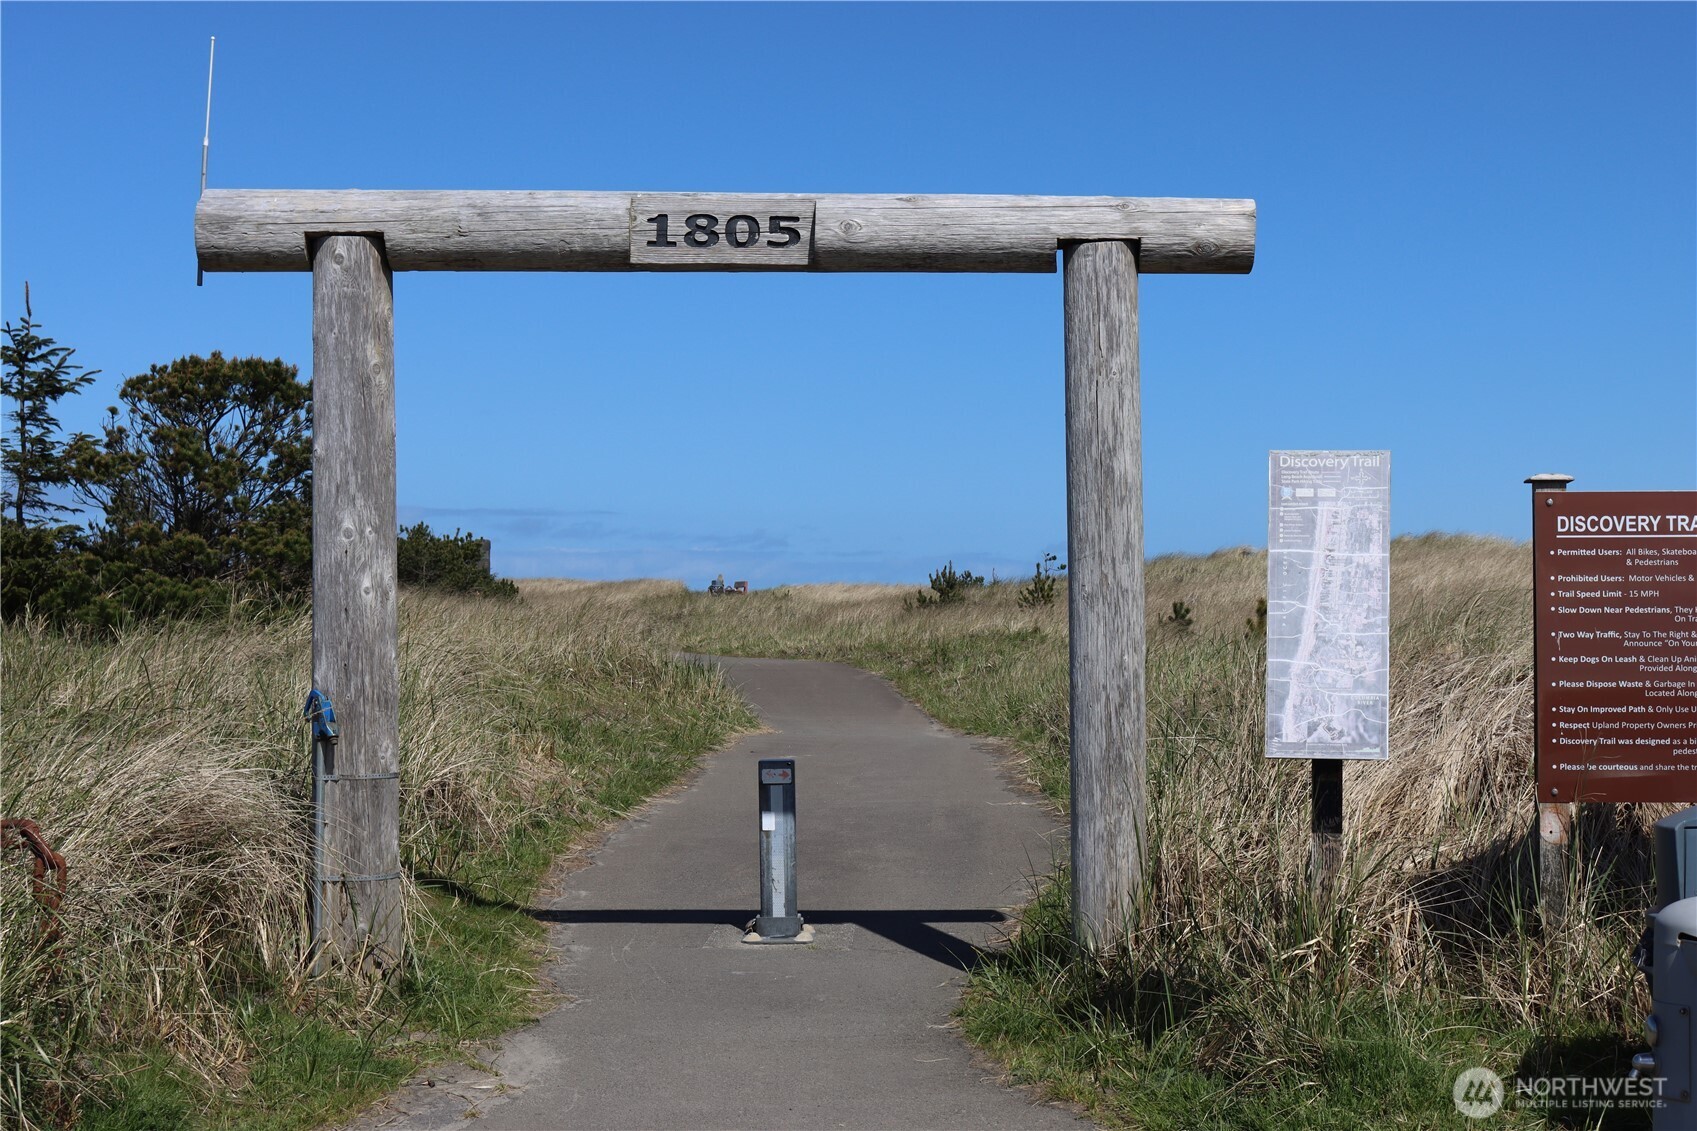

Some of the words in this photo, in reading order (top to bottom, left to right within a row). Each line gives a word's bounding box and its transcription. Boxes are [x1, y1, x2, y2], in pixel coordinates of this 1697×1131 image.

[647, 214, 800, 248] 1805
[1280, 456, 1348, 470] Discovery
[1352, 456, 1380, 467] Trail
[1557, 516, 1661, 532] DISCOVERY
[1638, 549, 1660, 557] Bikes,
[1577, 590, 1600, 598] Speed
[1625, 606, 1672, 614] Pedestrians,
[1674, 606, 1693, 614] They
